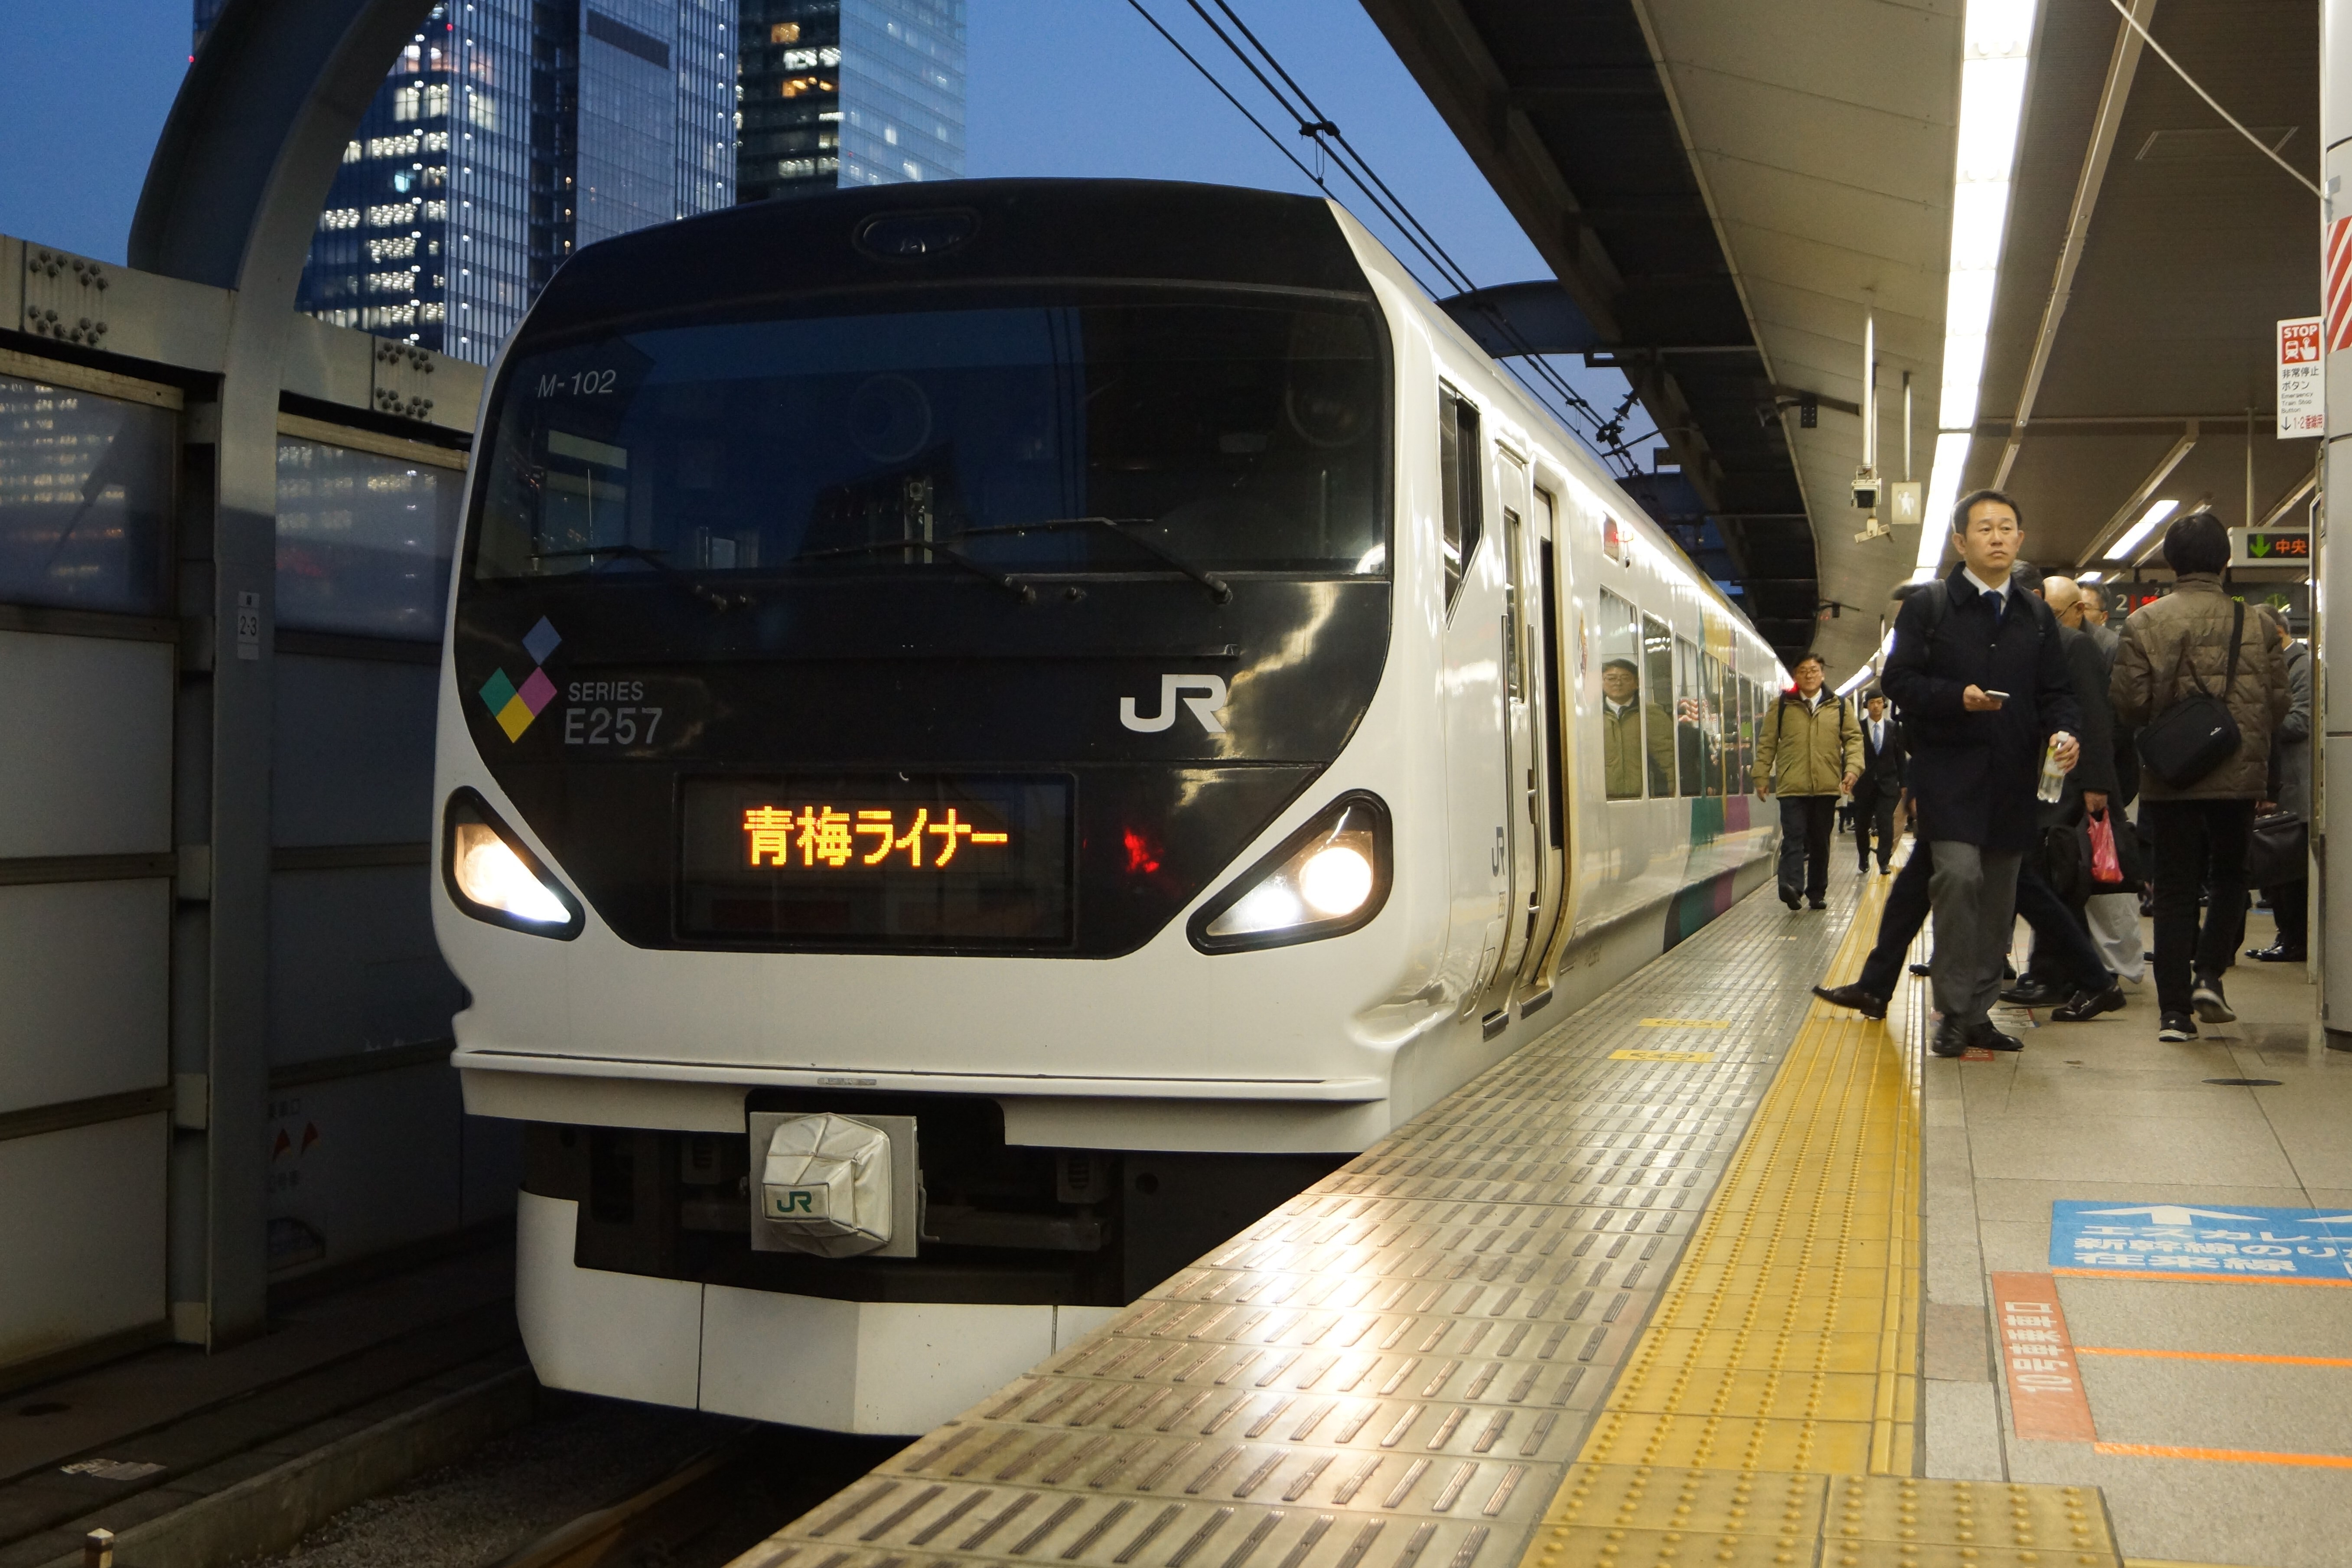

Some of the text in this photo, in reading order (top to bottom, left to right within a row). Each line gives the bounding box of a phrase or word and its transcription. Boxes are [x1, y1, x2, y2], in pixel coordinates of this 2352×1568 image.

[2283, 325, 2318, 339] STOP
[2282, 366, 2319, 378] 非常停止
[537, 369, 617, 398] M-102
[2282, 381, 2310, 391] ボタン
[2275, 538, 2307, 554] 中央
[2115, 594, 2128, 611] 2
[568, 681, 644, 701] SERIES
[1120, 674, 1227, 733] JR
[564, 707, 663, 745] E257
[743, 805, 1008, 867] 青梅ライナー
[1491, 826, 1505, 878] JR
[776, 1191, 813, 1213] JR
[2074, 1238, 2352, 1258] 新幹線のり
[2074, 1252, 2298, 1272] 在来線
[2004, 1301, 2074, 1392] 10号車乗車口
